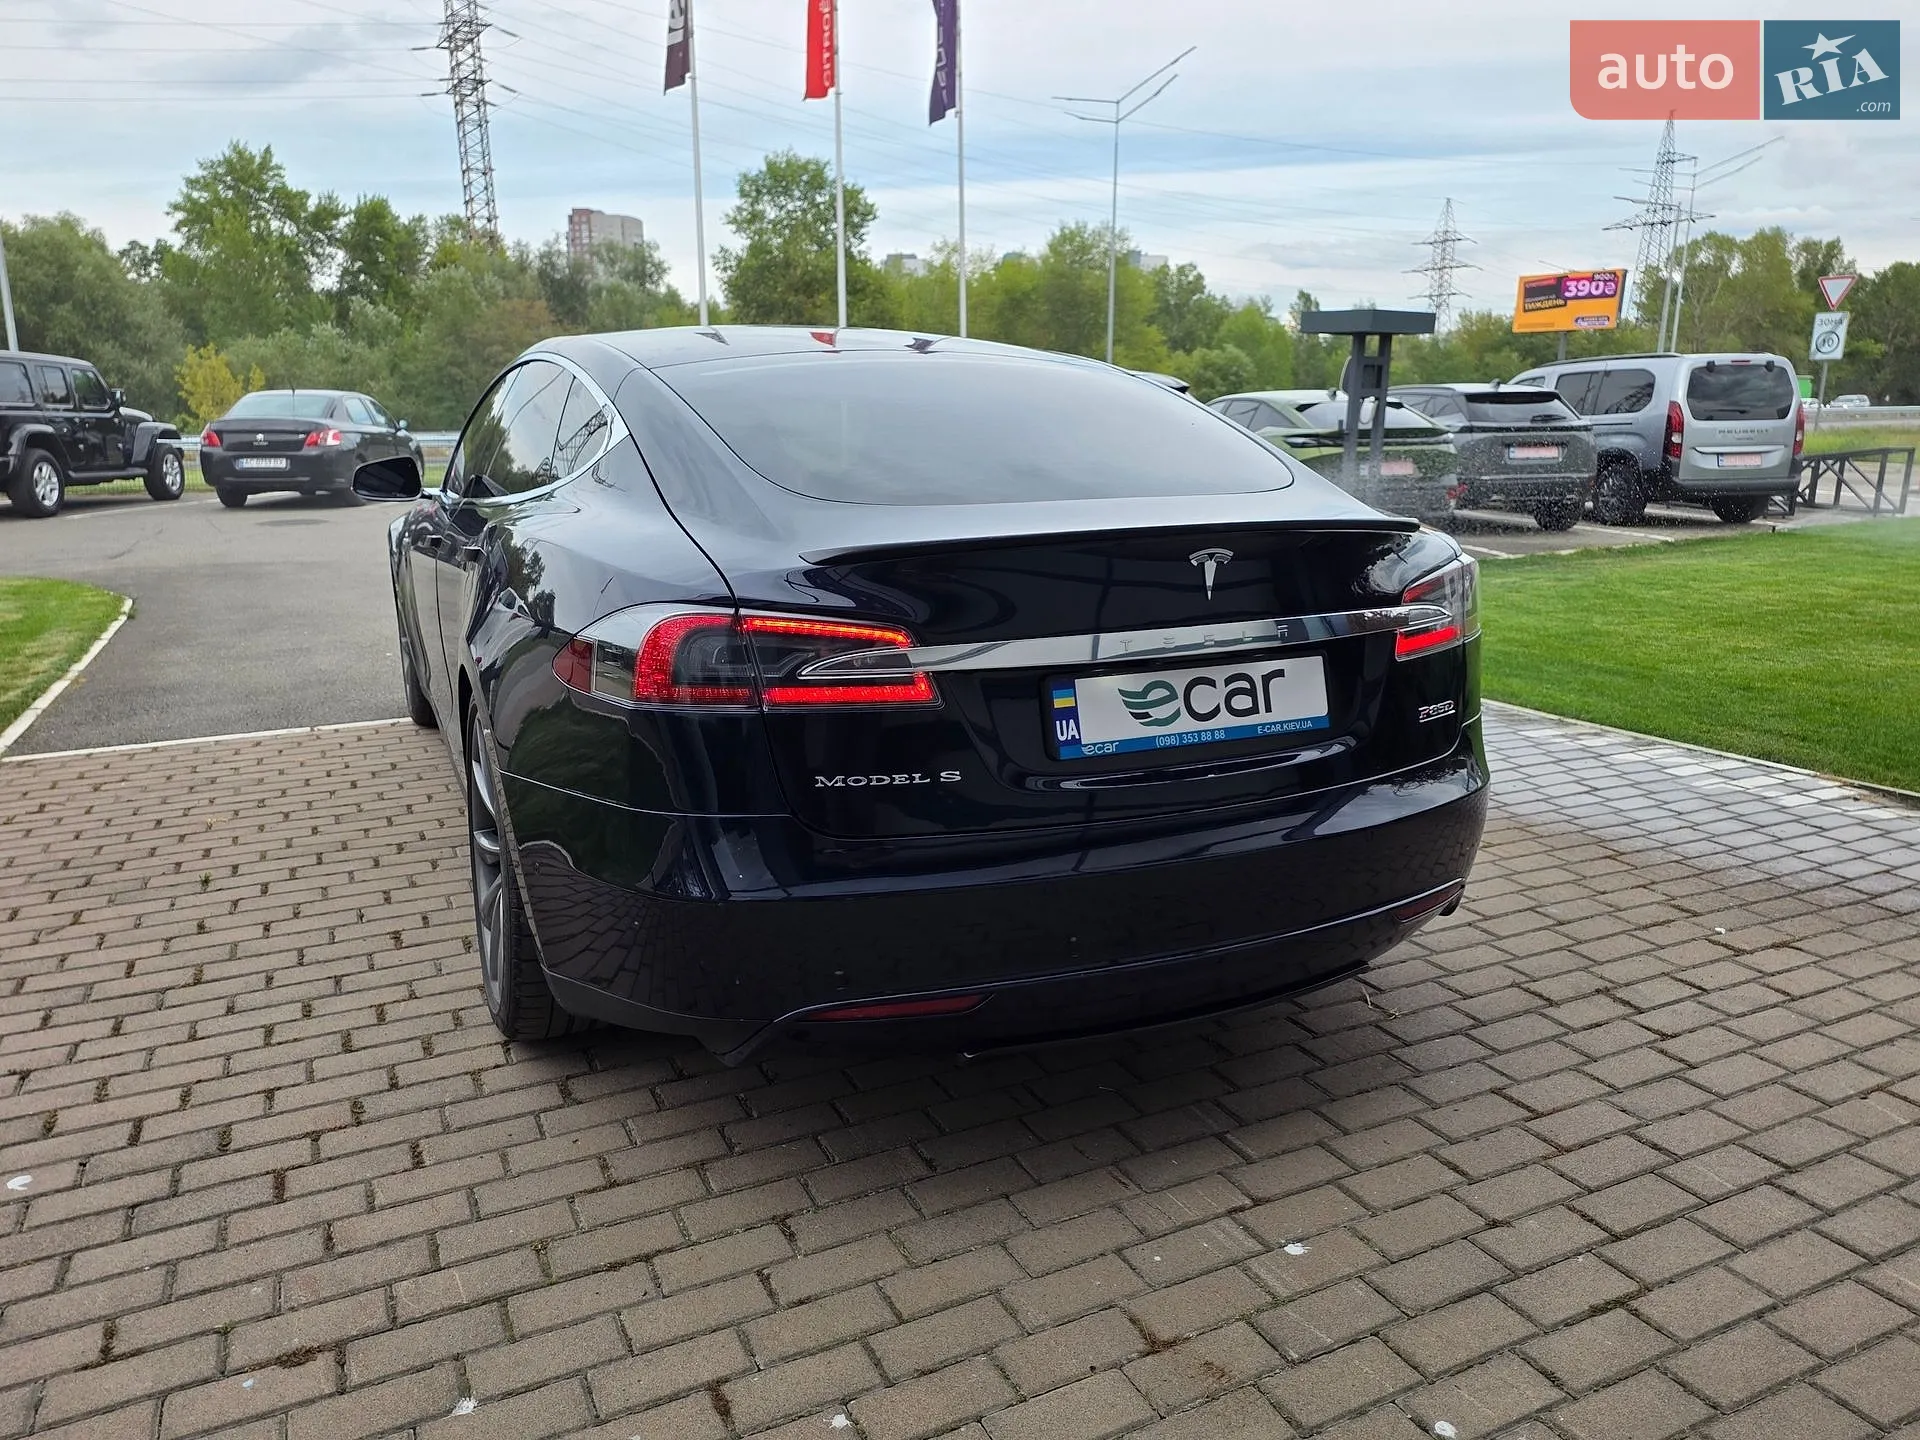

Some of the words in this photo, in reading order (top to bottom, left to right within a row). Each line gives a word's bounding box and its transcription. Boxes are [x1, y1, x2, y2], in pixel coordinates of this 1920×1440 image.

[1117, 668, 1286, 727] ecar
[1055, 718, 1080, 742] UA
[1257, 720, 1313, 735] E-CAR.KIEV.UA
[1081, 741, 1120, 755] ecar
[1155, 735, 1180, 748] (098)
[1182, 732, 1200, 745] 353
[1201, 731, 1213, 743] 88
[1214, 730, 1226, 741] 88
[814, 773, 931, 788] MODEL
[939, 770, 963, 783] S
